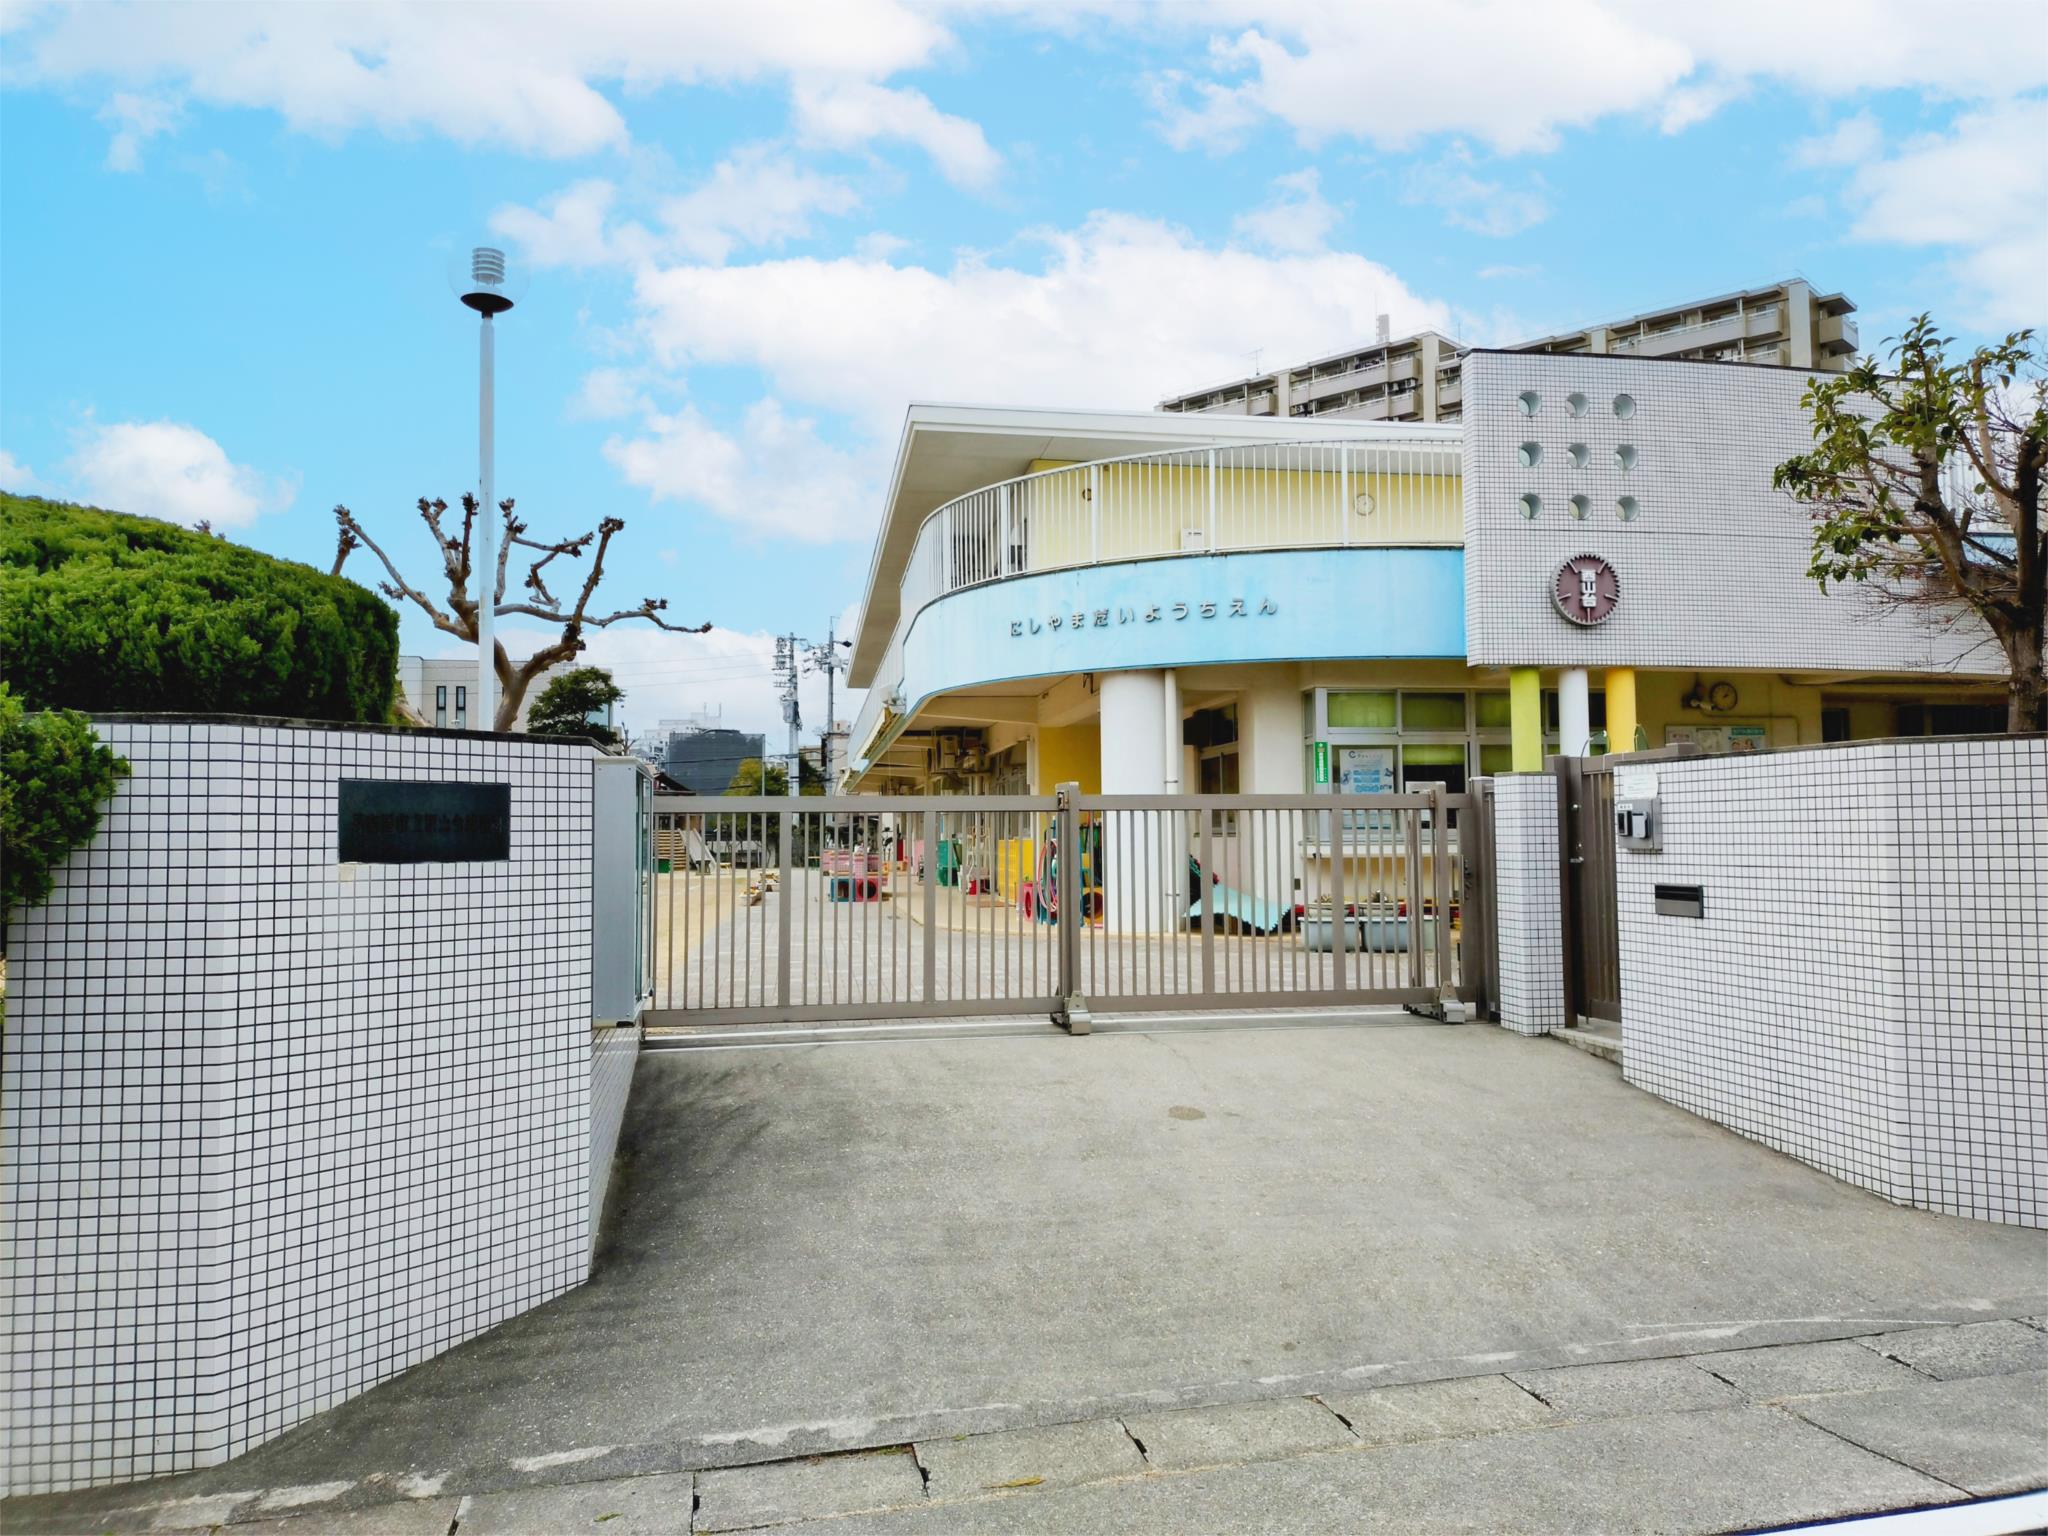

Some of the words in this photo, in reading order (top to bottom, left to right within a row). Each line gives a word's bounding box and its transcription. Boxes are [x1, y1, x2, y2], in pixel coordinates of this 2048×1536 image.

[1011, 597, 1277, 636] にしやまだいようちえん
